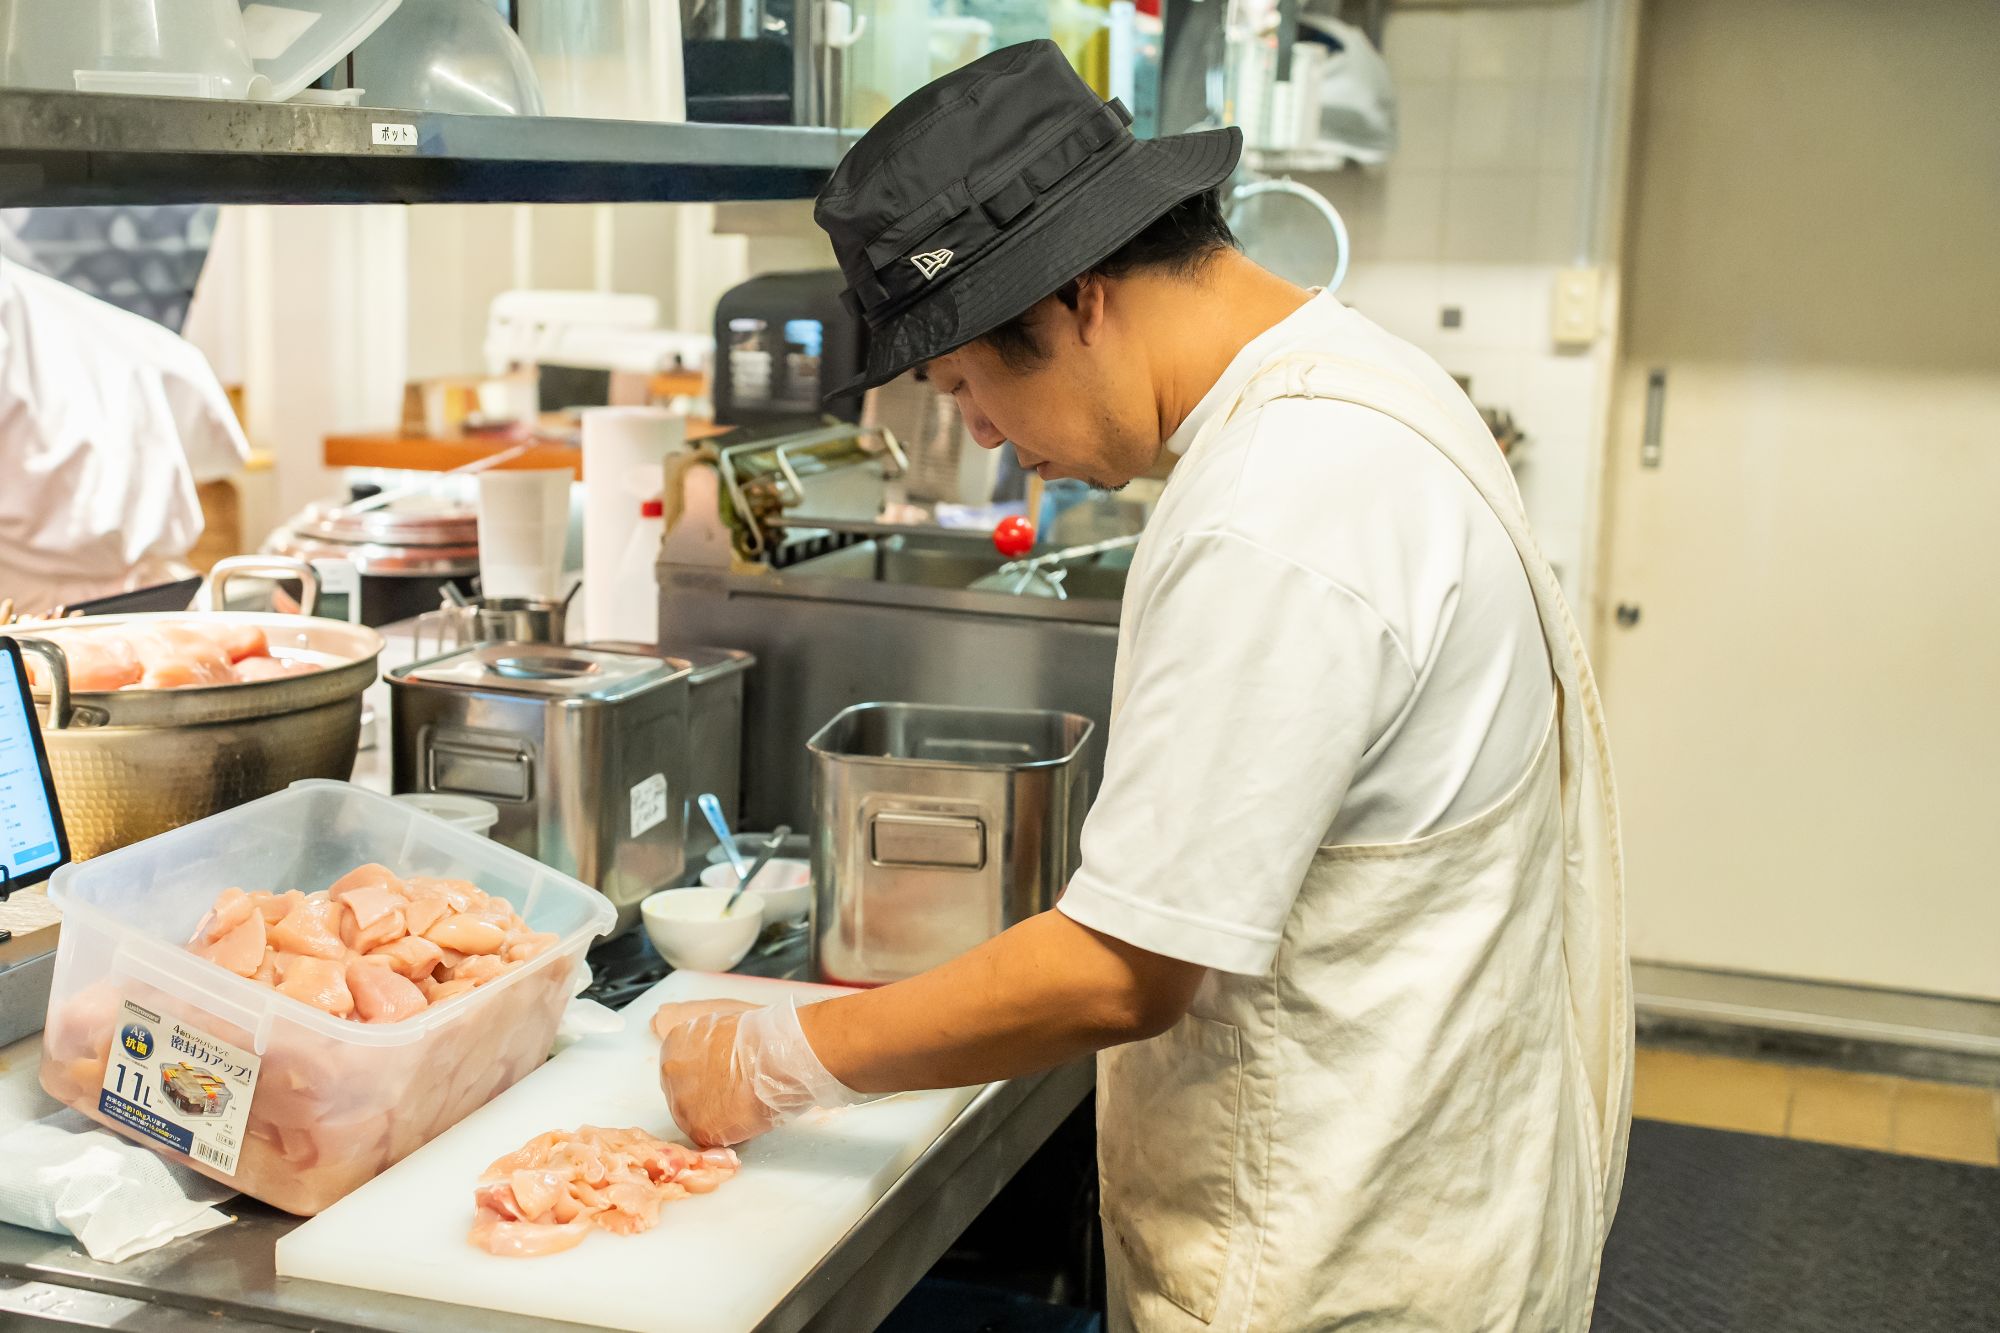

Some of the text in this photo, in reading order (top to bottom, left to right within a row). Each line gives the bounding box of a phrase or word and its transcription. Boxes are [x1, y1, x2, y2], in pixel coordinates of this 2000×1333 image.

[382, 126, 408, 142] ポット
[126, 1036, 148, 1056] 抗菌
